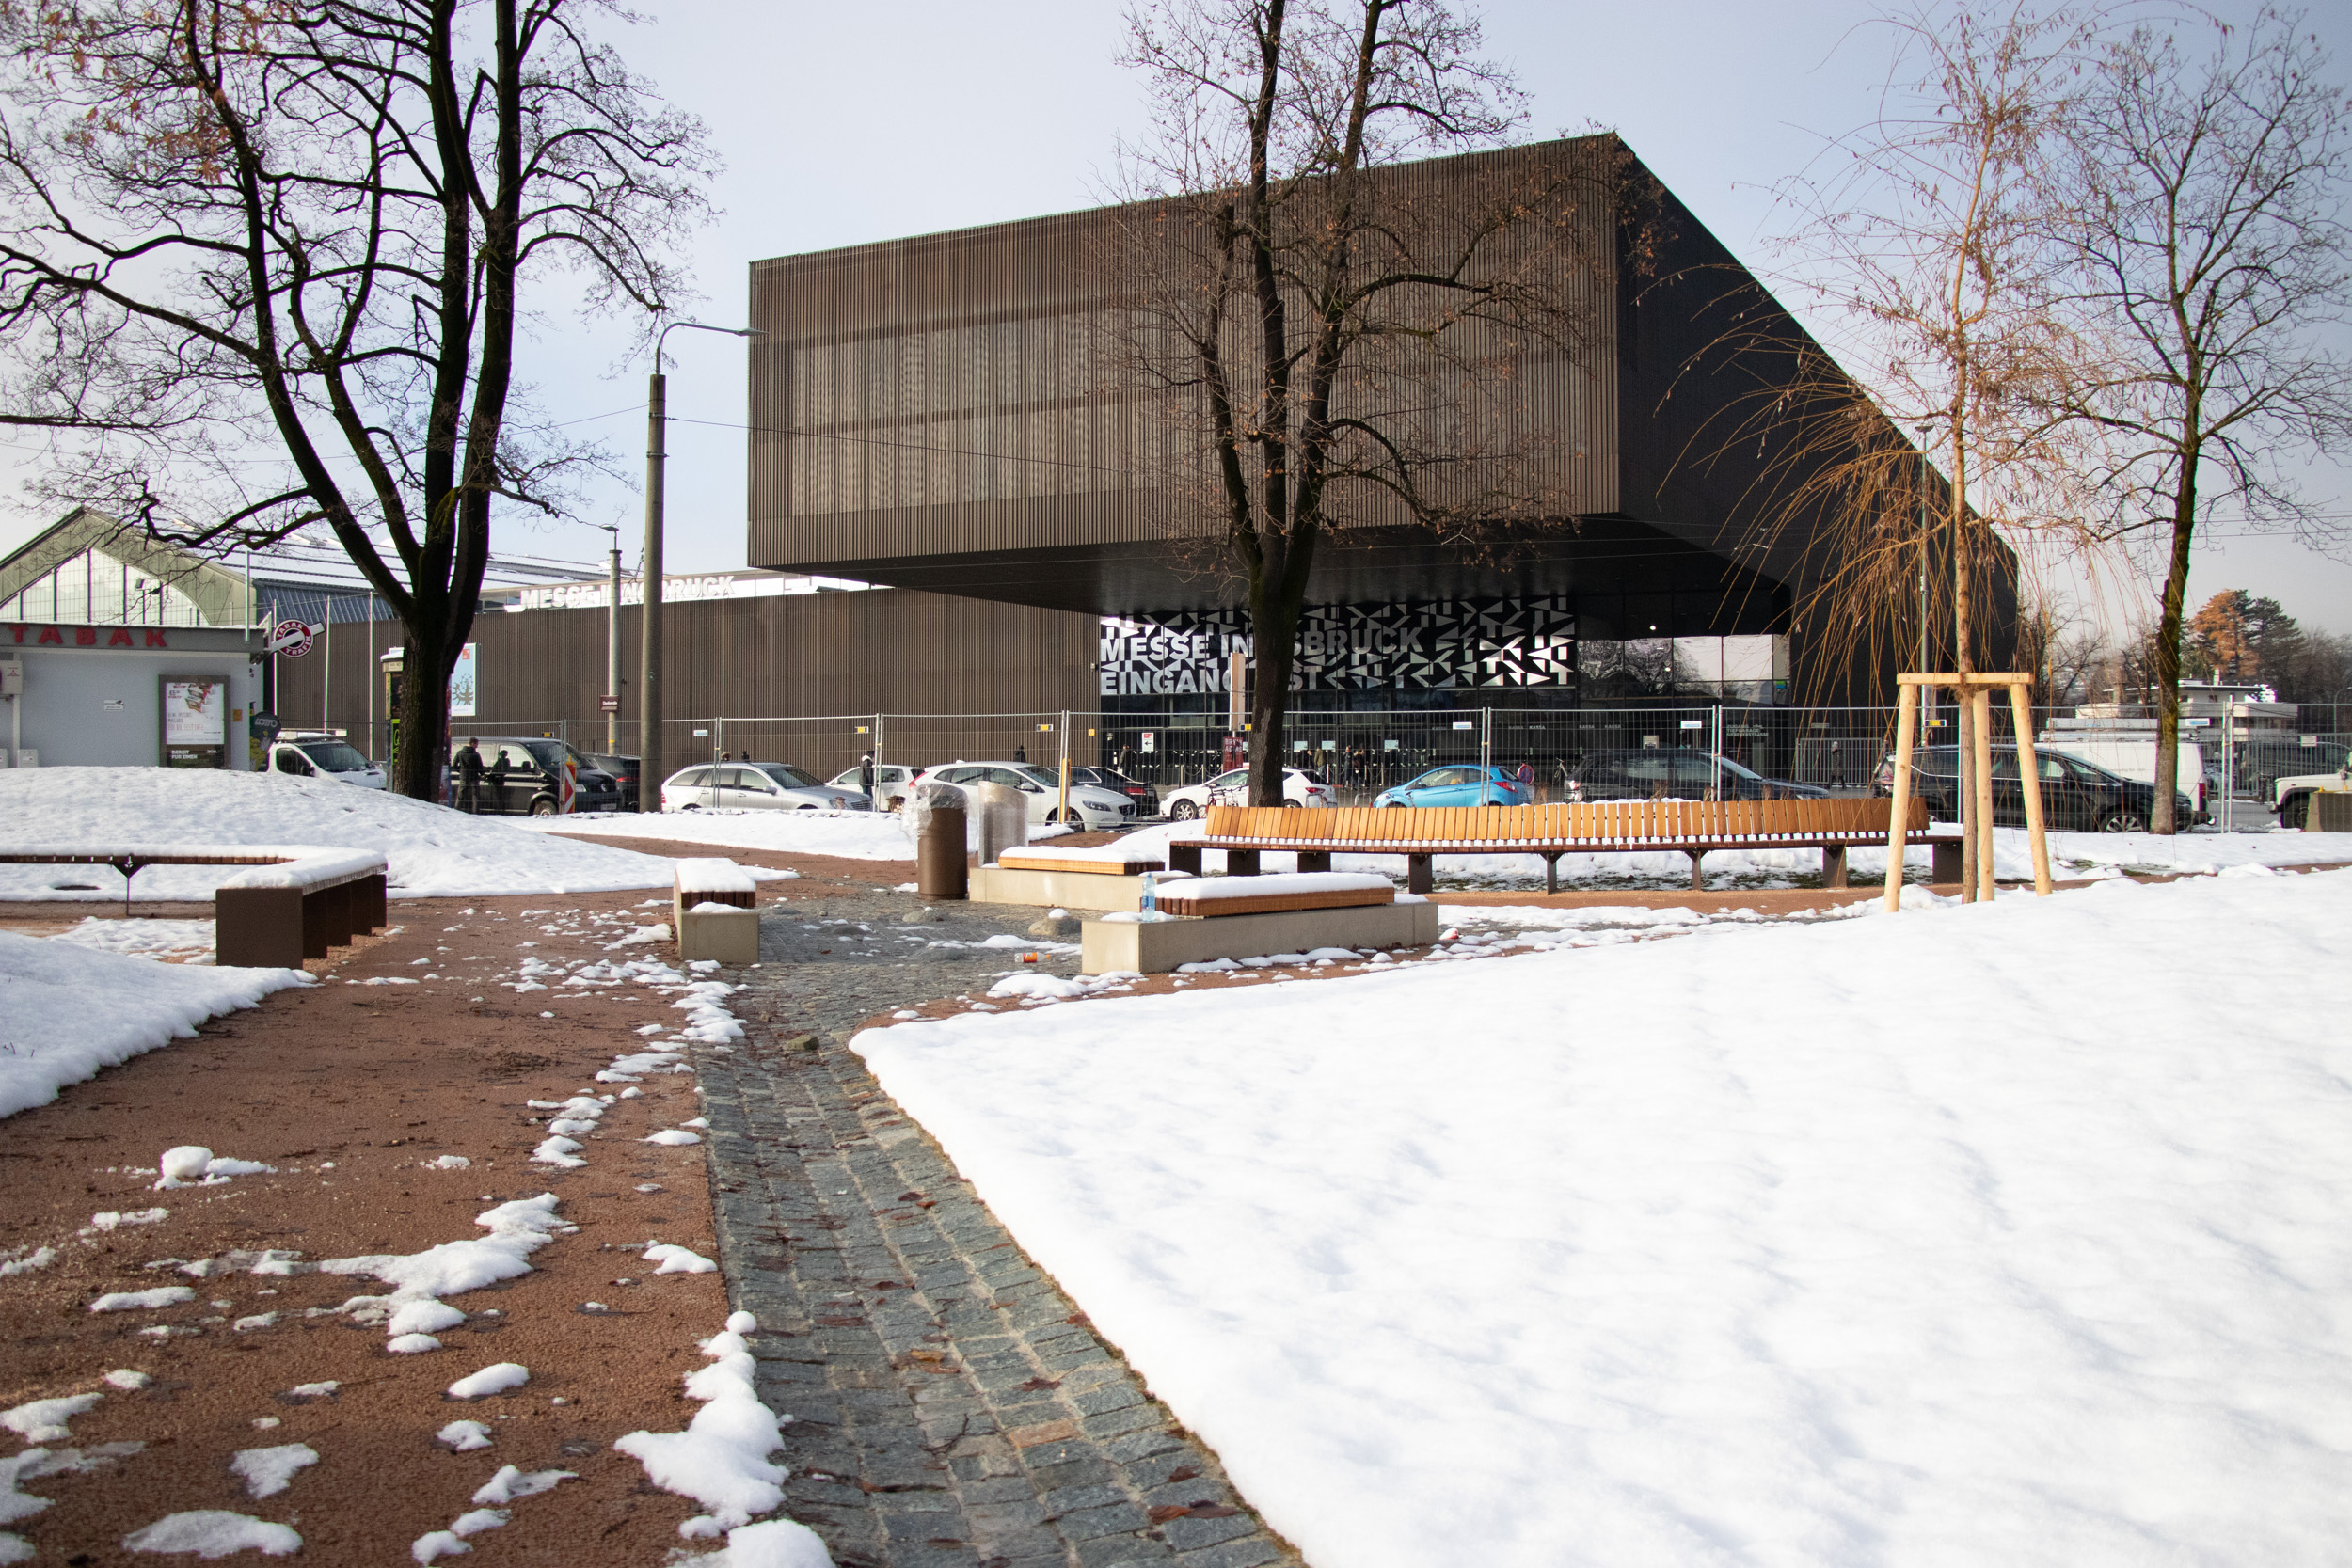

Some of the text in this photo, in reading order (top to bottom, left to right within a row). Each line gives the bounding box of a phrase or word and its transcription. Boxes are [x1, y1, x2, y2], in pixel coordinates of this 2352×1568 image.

[520, 585, 596, 609] MESSE
[8, 624, 167, 647] TABAK
[277, 622, 304, 639] TABAK
[286, 635, 311, 655] TRAFIK
[1101, 635, 1210, 662] MESSE
[255, 718, 278, 728] LOTTO
